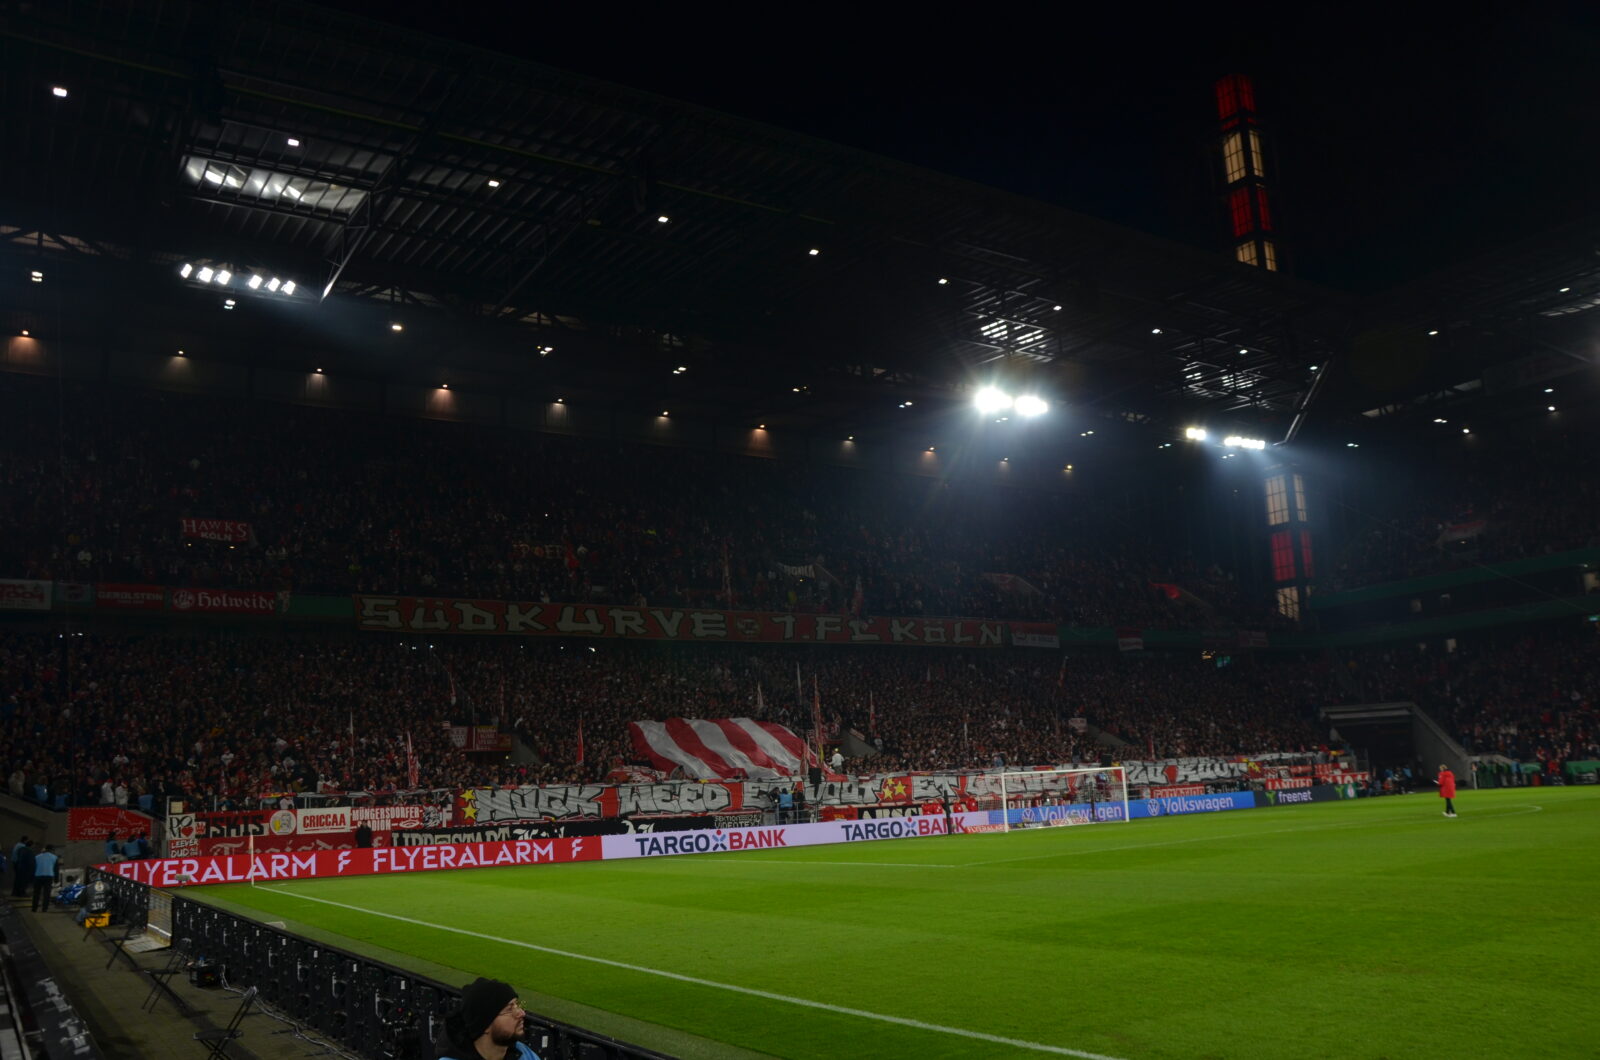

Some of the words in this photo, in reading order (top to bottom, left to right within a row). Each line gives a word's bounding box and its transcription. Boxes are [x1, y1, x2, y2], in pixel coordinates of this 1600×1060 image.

[182, 519, 249, 538] HAWKS
[358, 597, 728, 639] SÜDKURVE
[890, 618, 1003, 645] KÖLN
[1278, 789, 1313, 803] freenet
[1162, 796, 1234, 813] Volkswagen
[302, 813, 347, 829] CRICCAA
[351, 806, 420, 821] MÜNGERSDORFER
[170, 839, 199, 849] LEEVER
[119, 853, 316, 887] FLYERALARM
[373, 840, 554, 872] FLYERALARM
